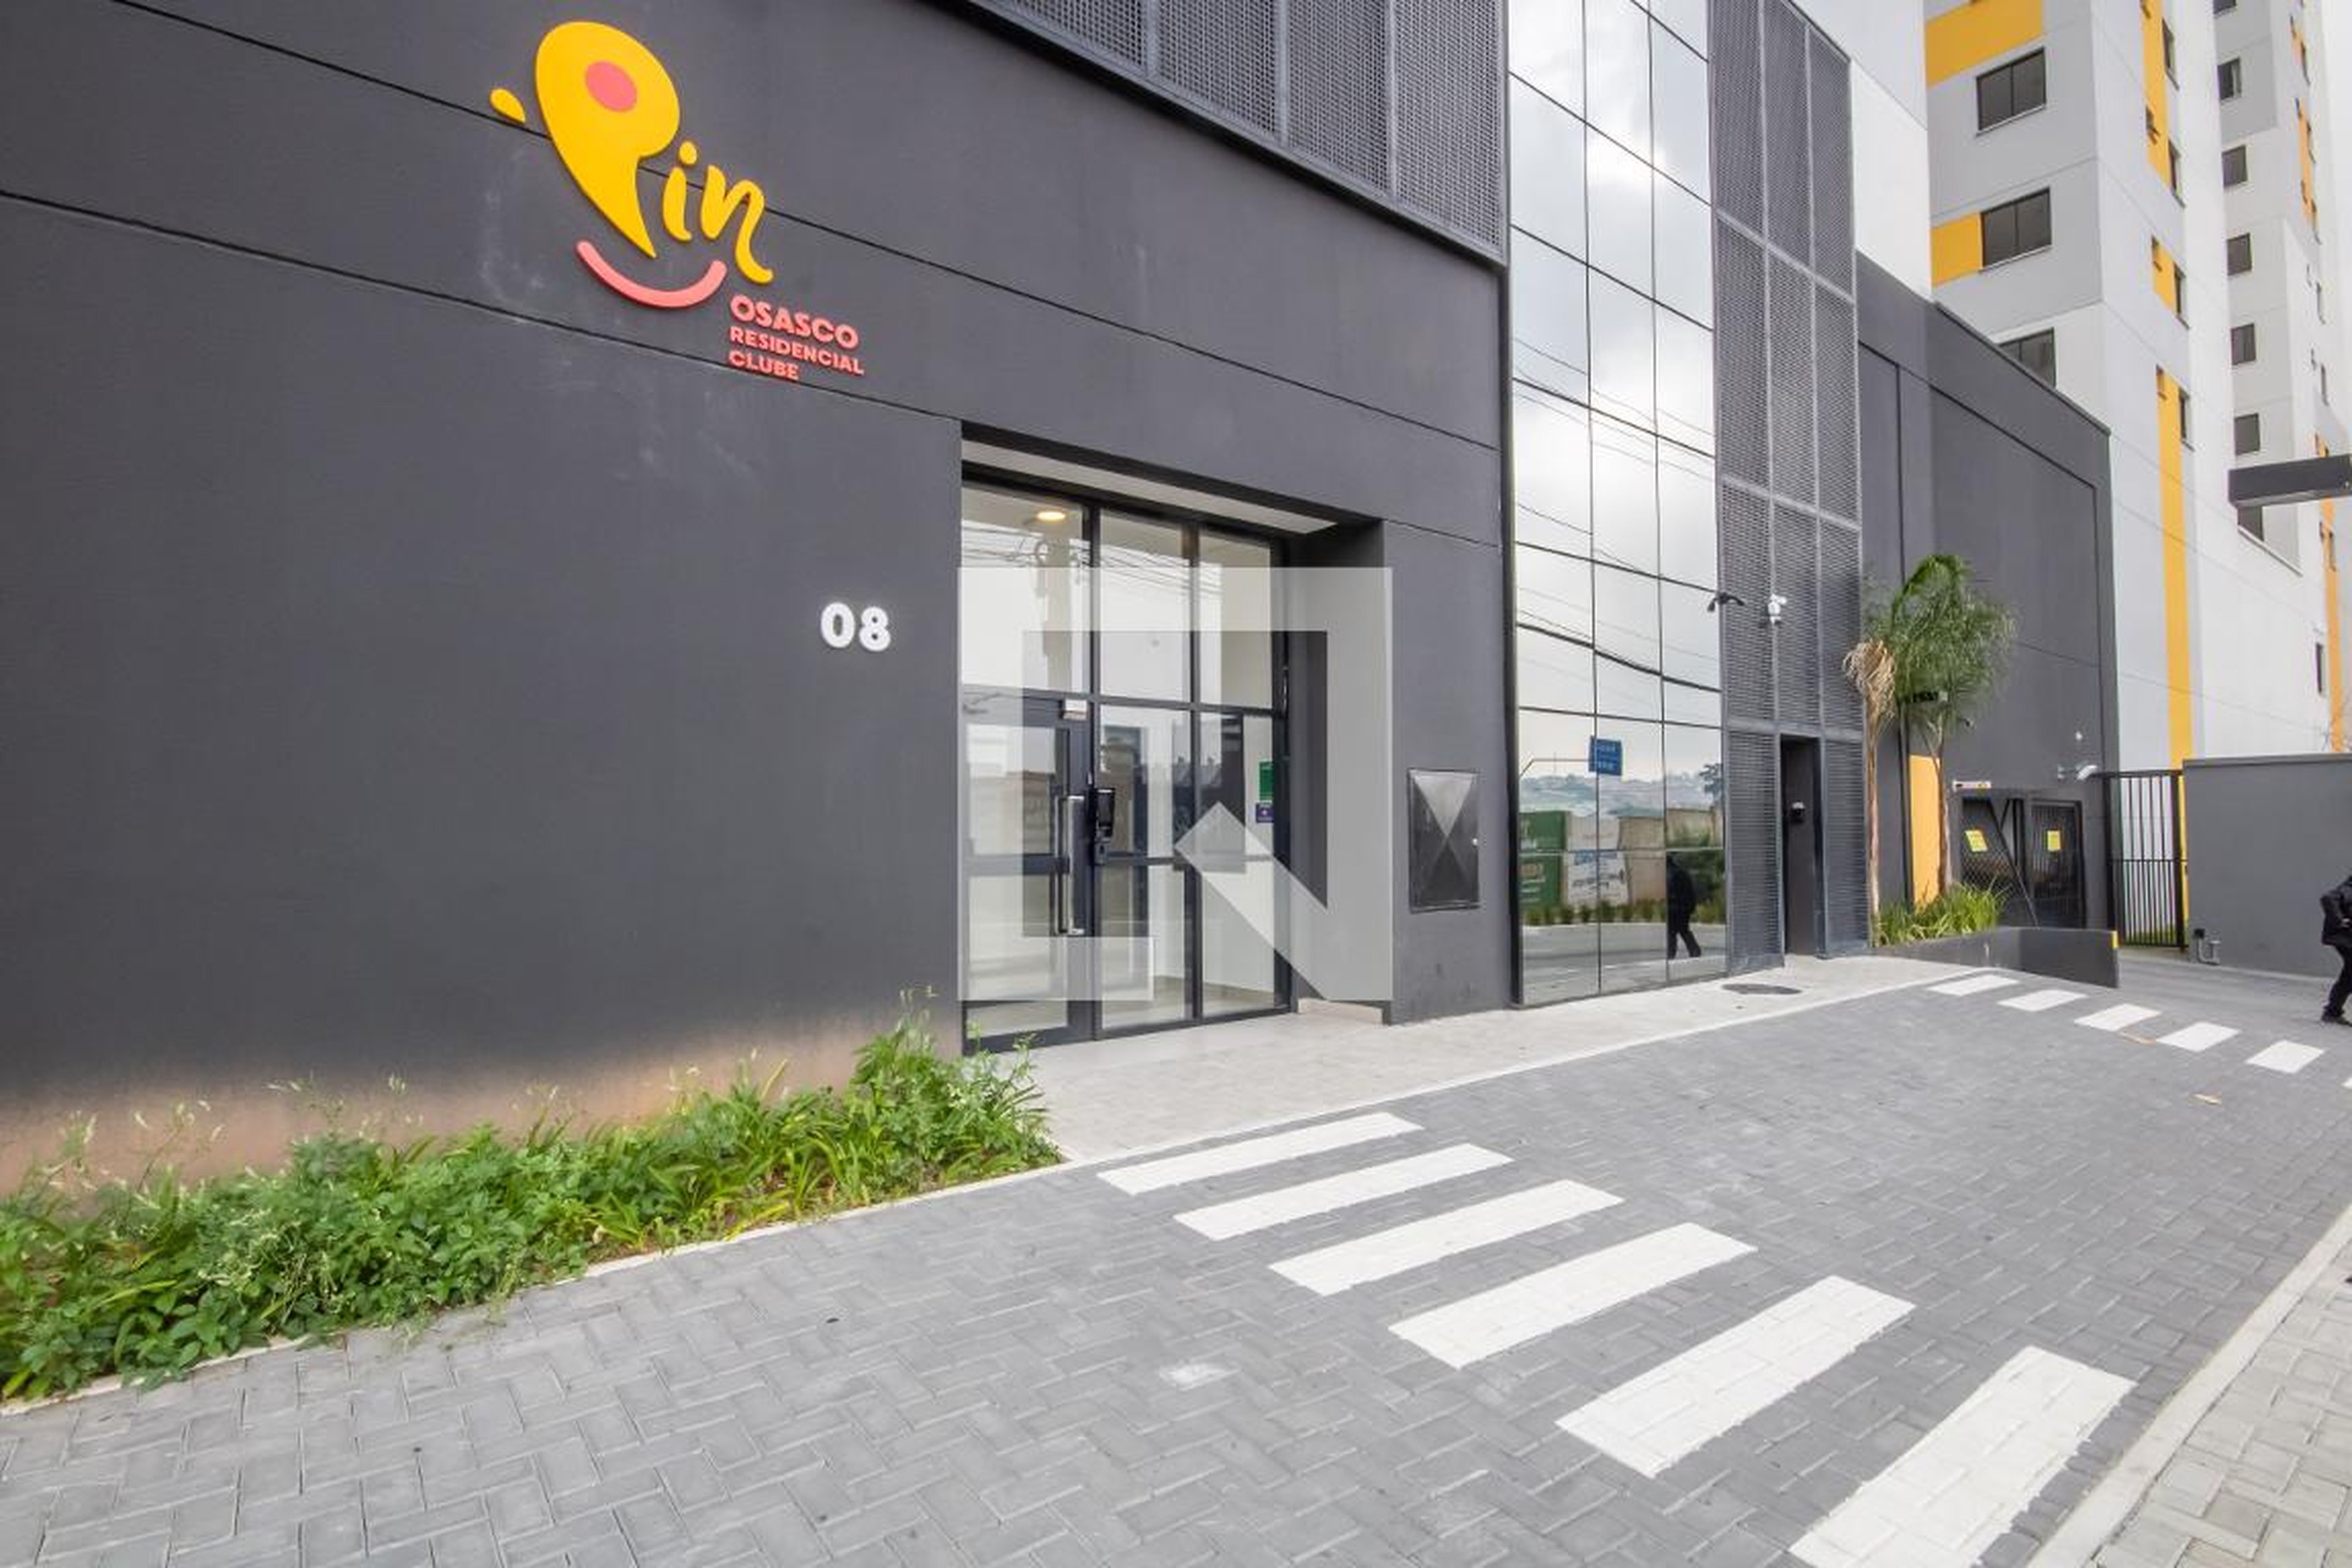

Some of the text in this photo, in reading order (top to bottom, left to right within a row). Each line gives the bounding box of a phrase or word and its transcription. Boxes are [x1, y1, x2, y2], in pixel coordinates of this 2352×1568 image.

[534, 21, 774, 284] Pin
[730, 294, 859, 349] OSASCO
[728, 349, 799, 380] CLUBE
[729, 325, 865, 376] RESIDENCIAL
[821, 601, 891, 652] 08
